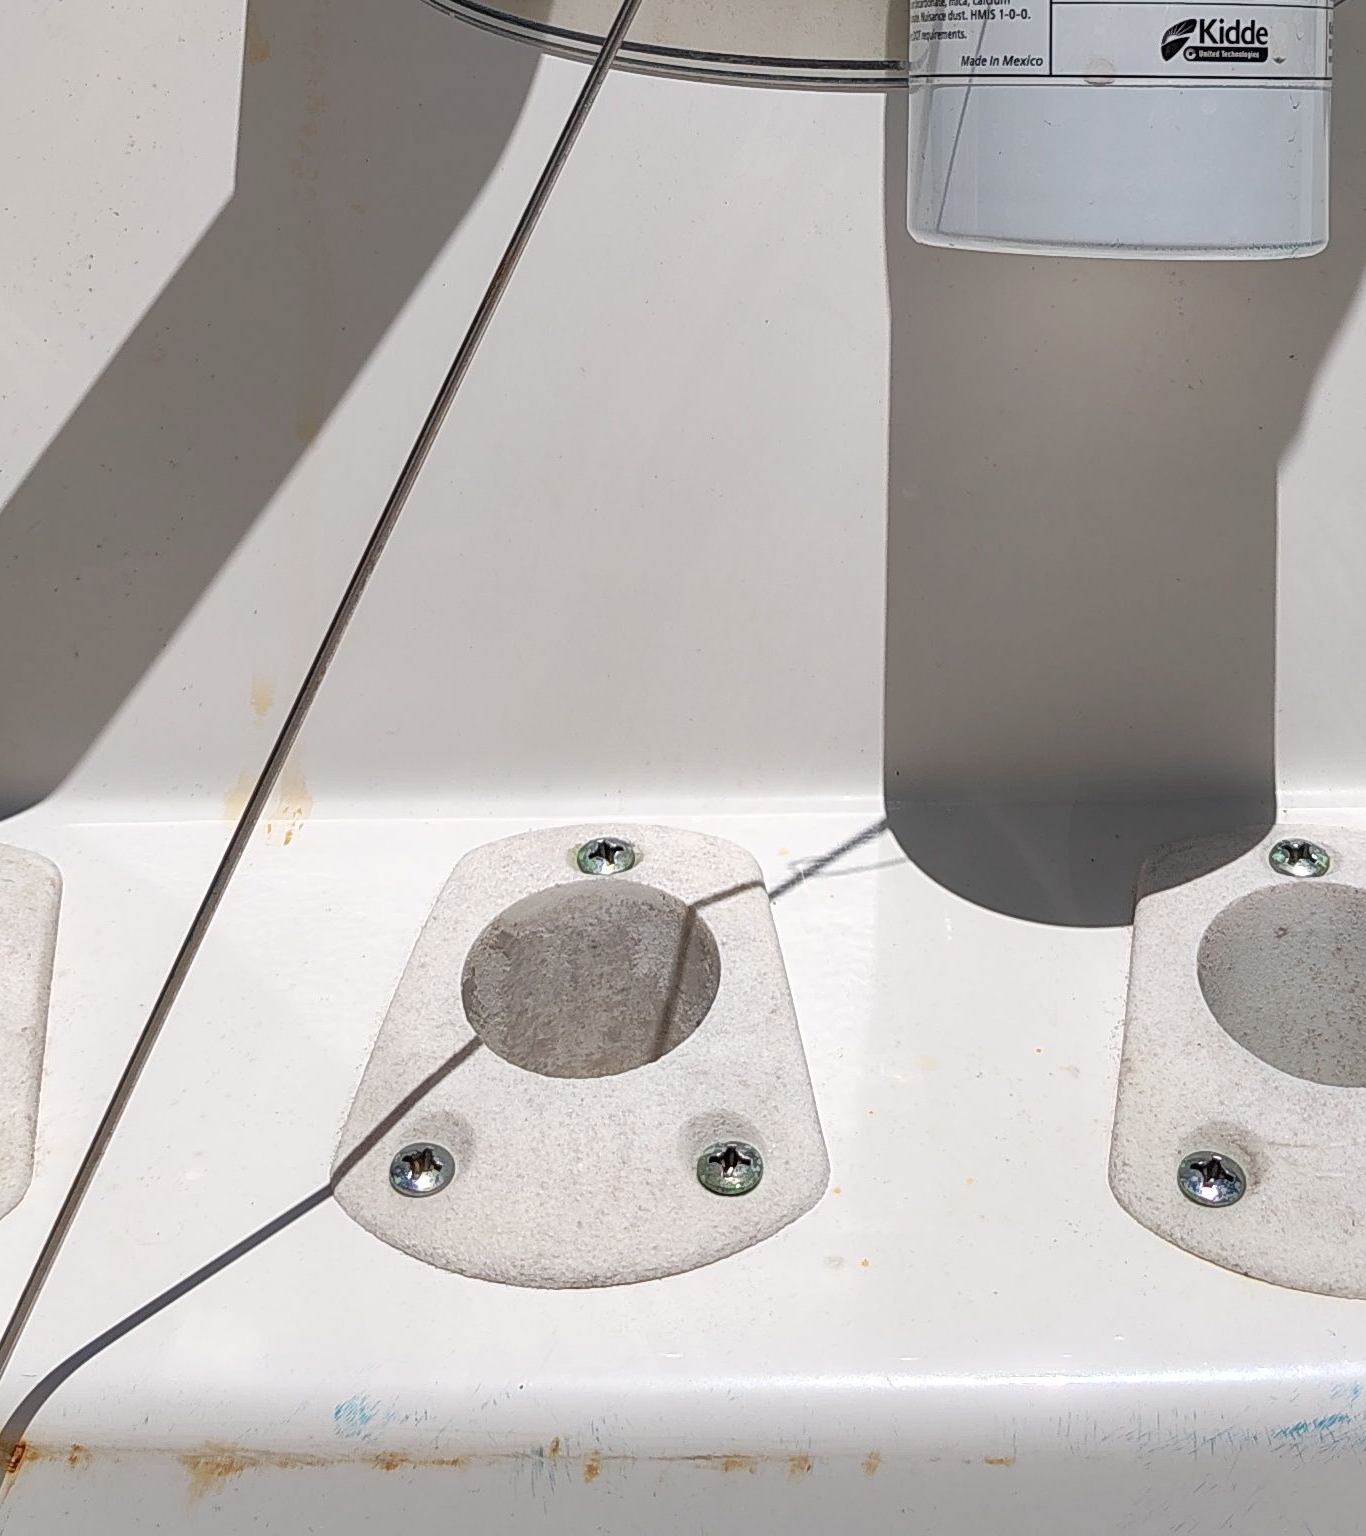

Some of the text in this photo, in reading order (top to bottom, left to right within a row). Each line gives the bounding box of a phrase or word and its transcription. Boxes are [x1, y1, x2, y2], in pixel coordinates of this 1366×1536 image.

[948, 10, 968, 20] dust.
[971, 9, 995, 20] HMIS
[1000, 9, 1031, 20] 1-0-0.
[1199, 18, 1268, 45] Kidde
[1222, 50, 1259, 59] Technologies
[961, 55, 1043, 67] Made In Mexico
